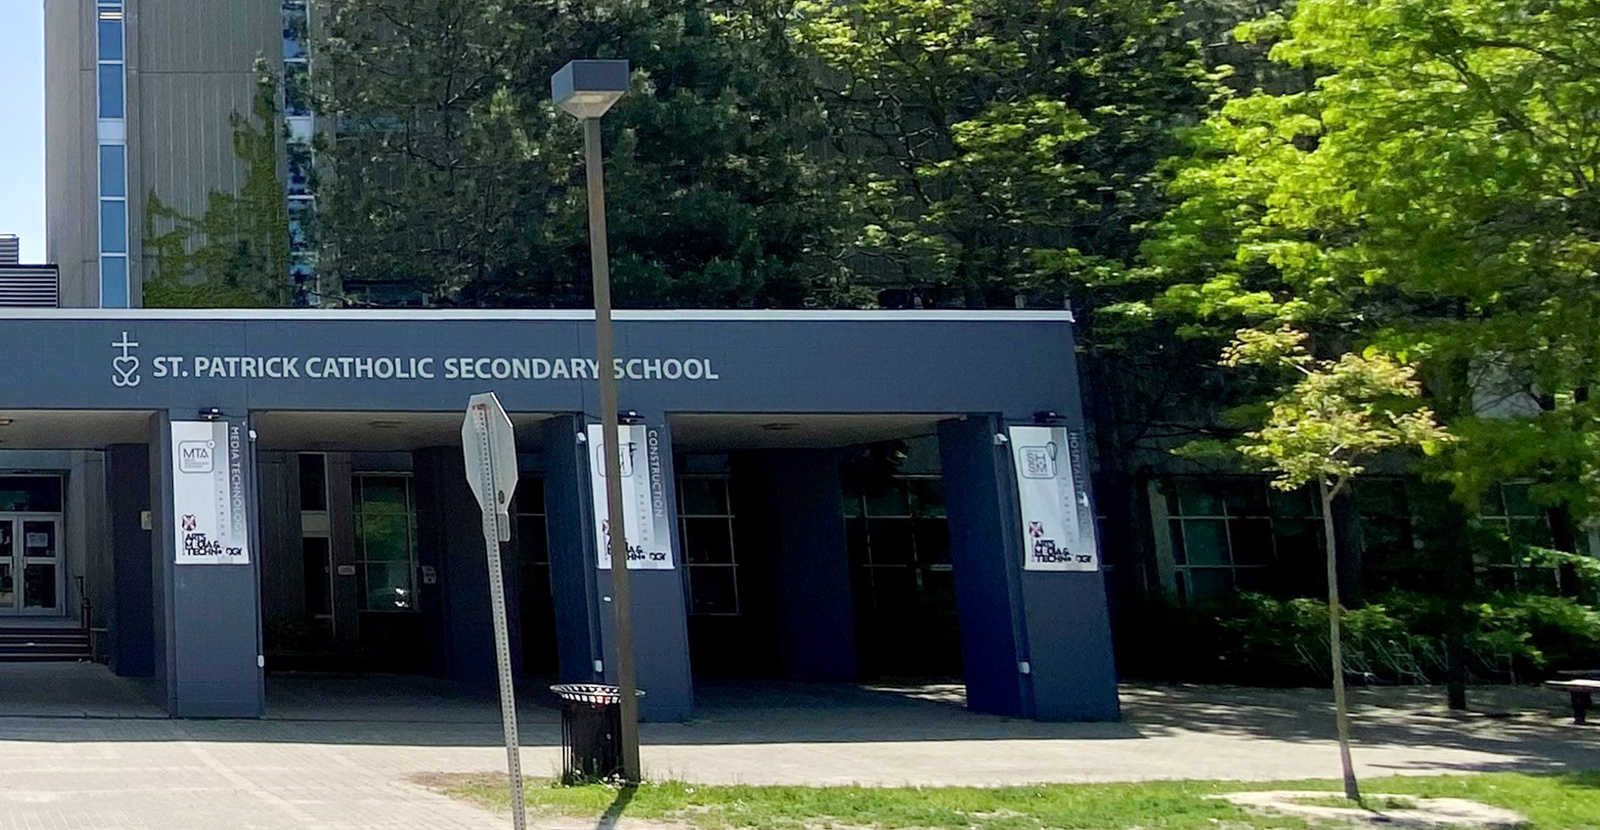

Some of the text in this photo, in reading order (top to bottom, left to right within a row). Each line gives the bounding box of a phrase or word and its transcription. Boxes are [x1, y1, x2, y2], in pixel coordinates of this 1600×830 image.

[153, 357, 719, 380] ST. PATRICK CATHOLIC SECONDARY SCHOOL
[229, 426, 240, 460] MEDIA
[183, 448, 209, 458] MTA
[648, 429, 663, 518] CONSTRUCTION
[186, 533, 206, 541] ARTS
[186, 548, 242, 556] TECHNOOGY
[1035, 555, 1092, 563] TECHNOOGY
